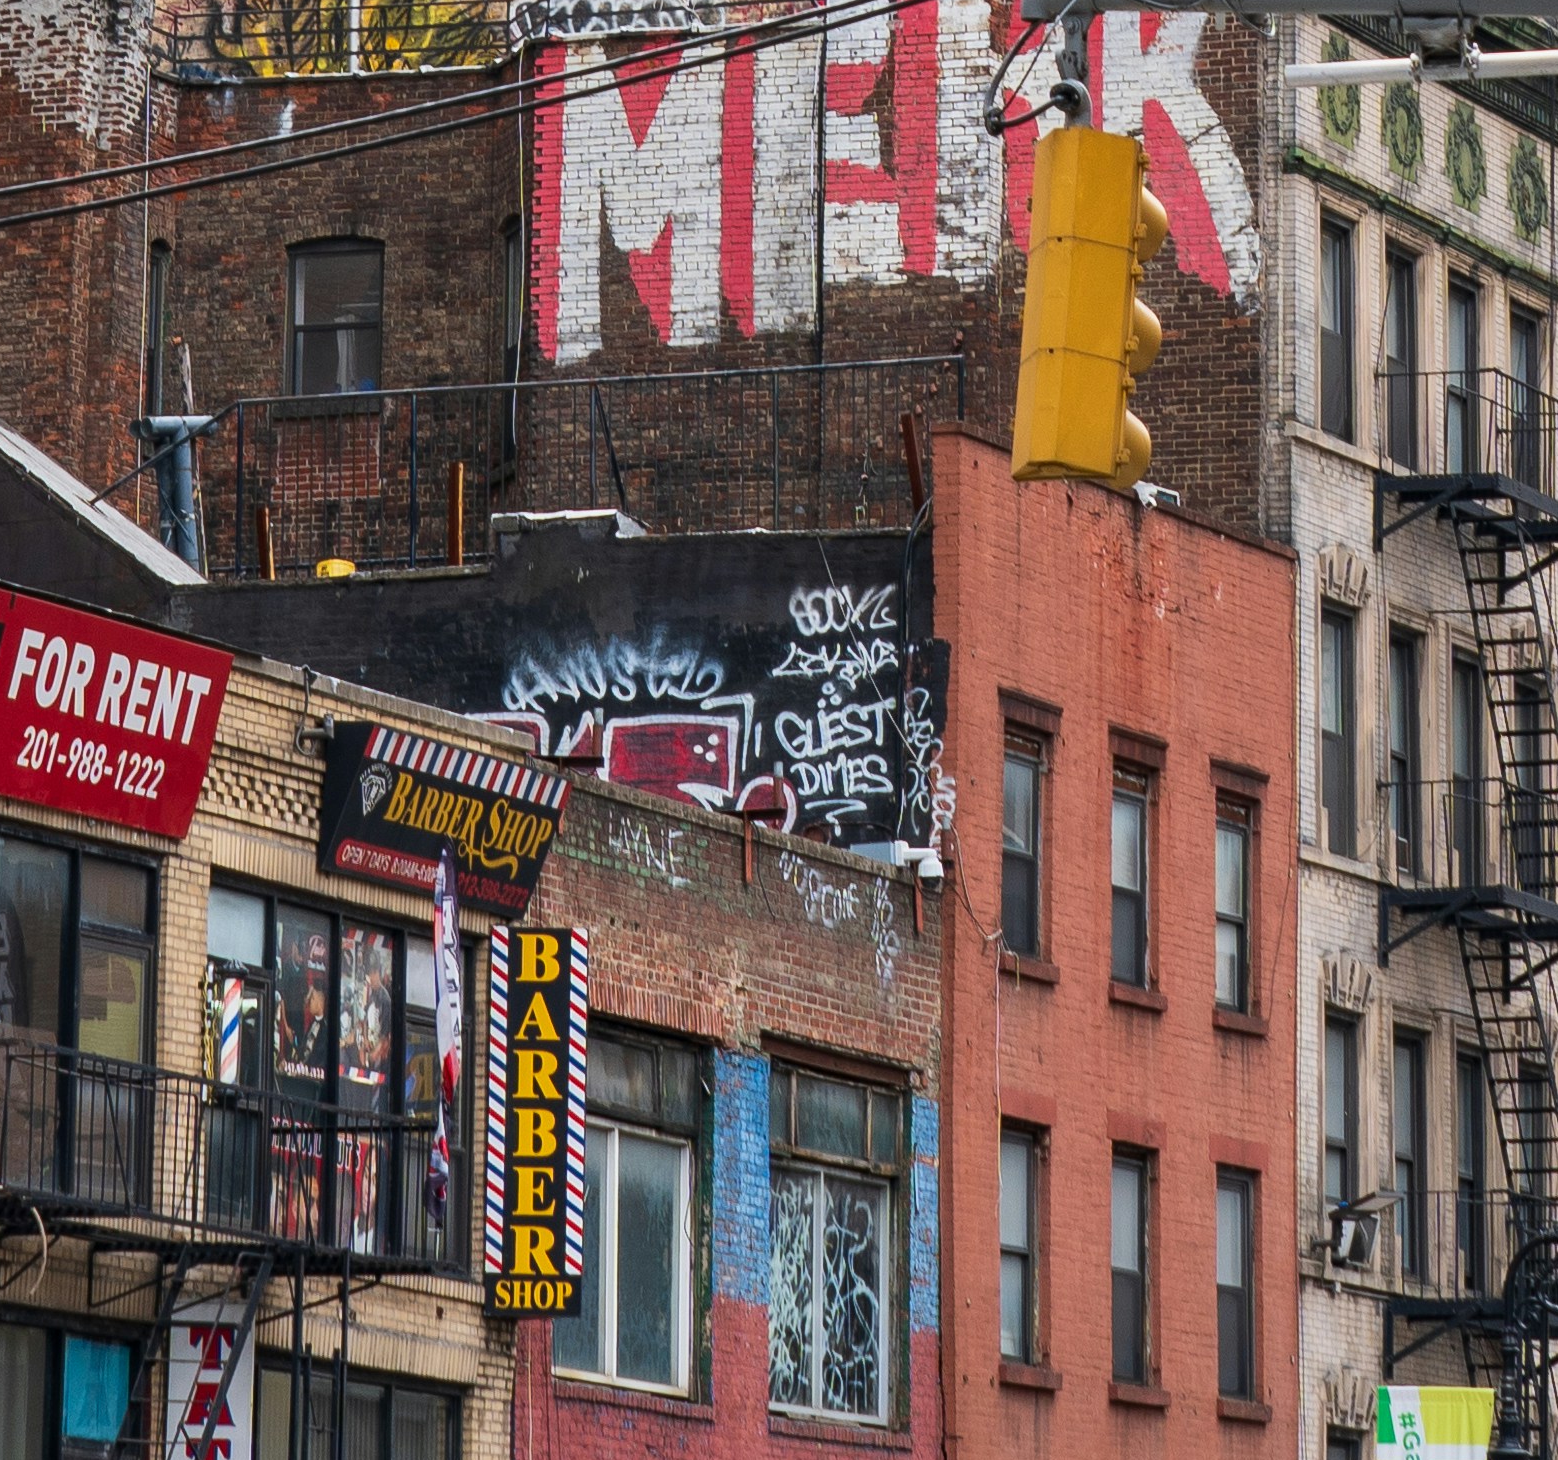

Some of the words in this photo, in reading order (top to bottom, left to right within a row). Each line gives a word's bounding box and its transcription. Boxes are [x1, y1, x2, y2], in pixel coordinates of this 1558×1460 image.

[7, 627, 96, 718] FOR
[96, 652, 212, 746] RENT
[16, 725, 166, 800] 201-988-1222
[383, 771, 484, 844] BARBER
[483, 798, 553, 860] SHOP
[341, 844, 364, 866] OPEN
[369, 853, 392, 872] DAYS
[510, 933, 563, 1276] BARBER
[495, 1280, 574, 1310] SHOP
